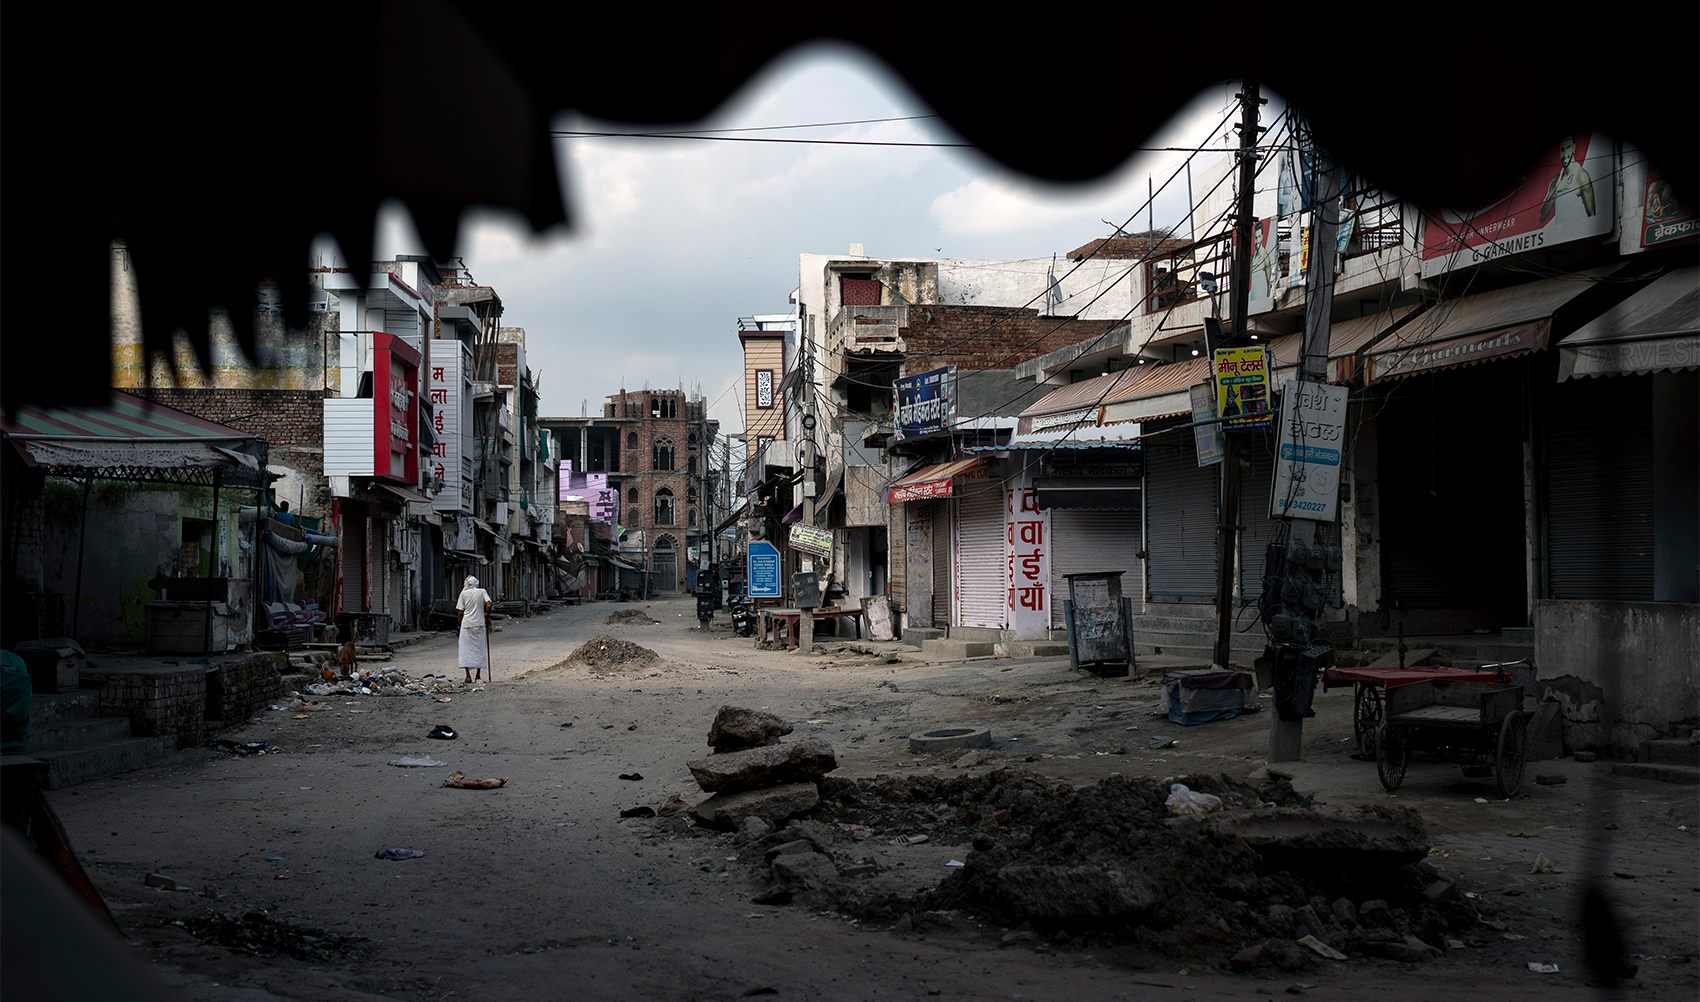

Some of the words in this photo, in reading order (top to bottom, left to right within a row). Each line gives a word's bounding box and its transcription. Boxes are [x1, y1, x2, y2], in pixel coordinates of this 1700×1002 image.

[1472, 249, 1480, 262] G
[1483, 232, 1545, 259] GARMNETS
[1411, 332, 1523, 367] Garments
[1218, 357, 1242, 377] मीनू
[1240, 354, 1265, 373] टेलर्स
[1087, 462, 1129, 476] मेडिकल
[1278, 498, 1327, 512] 983420227
